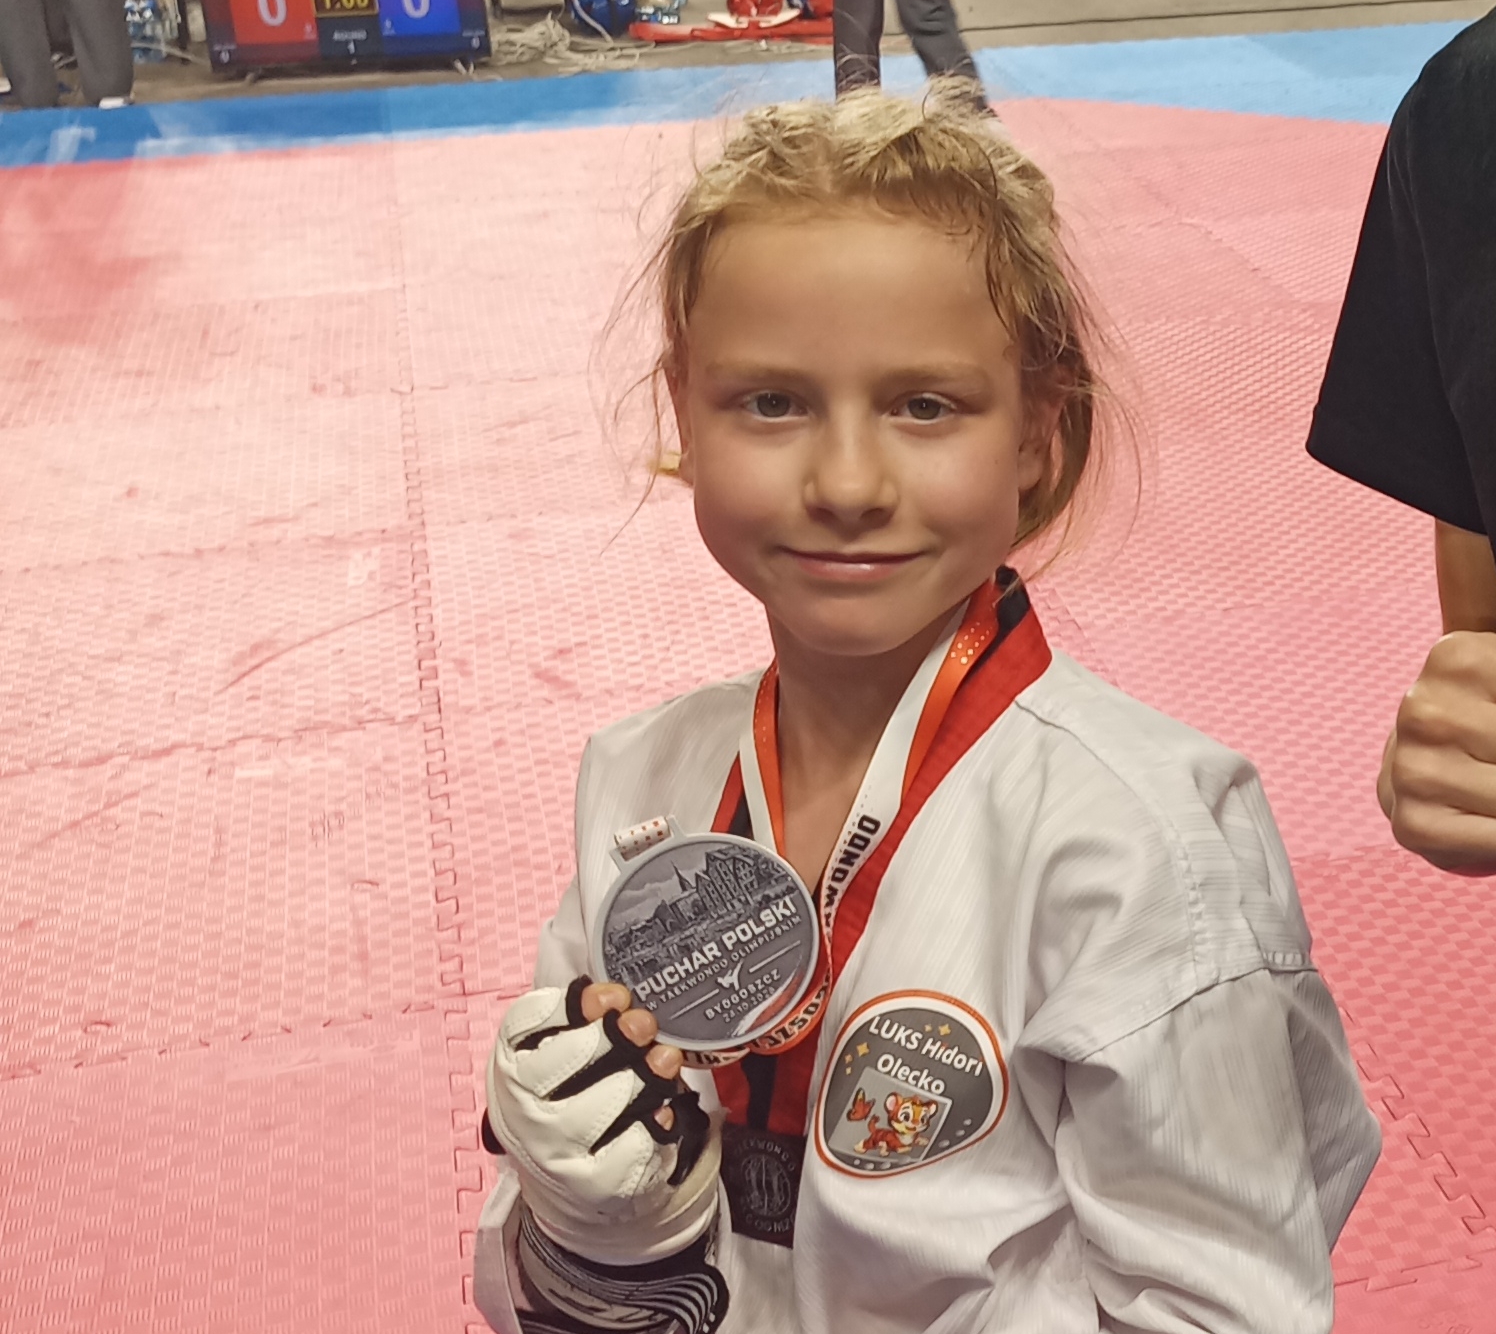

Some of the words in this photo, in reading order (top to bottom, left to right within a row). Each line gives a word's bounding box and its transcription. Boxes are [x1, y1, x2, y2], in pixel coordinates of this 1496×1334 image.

[633, 941, 722, 1002] PUCHAR
[722, 896, 797, 951] POLSKI
[659, 959, 728, 1003] TAEKWONDO
[868, 1016, 924, 1051] LUKS
[922, 1037, 984, 1077] Hidori
[877, 1053, 946, 1095] Olecko
